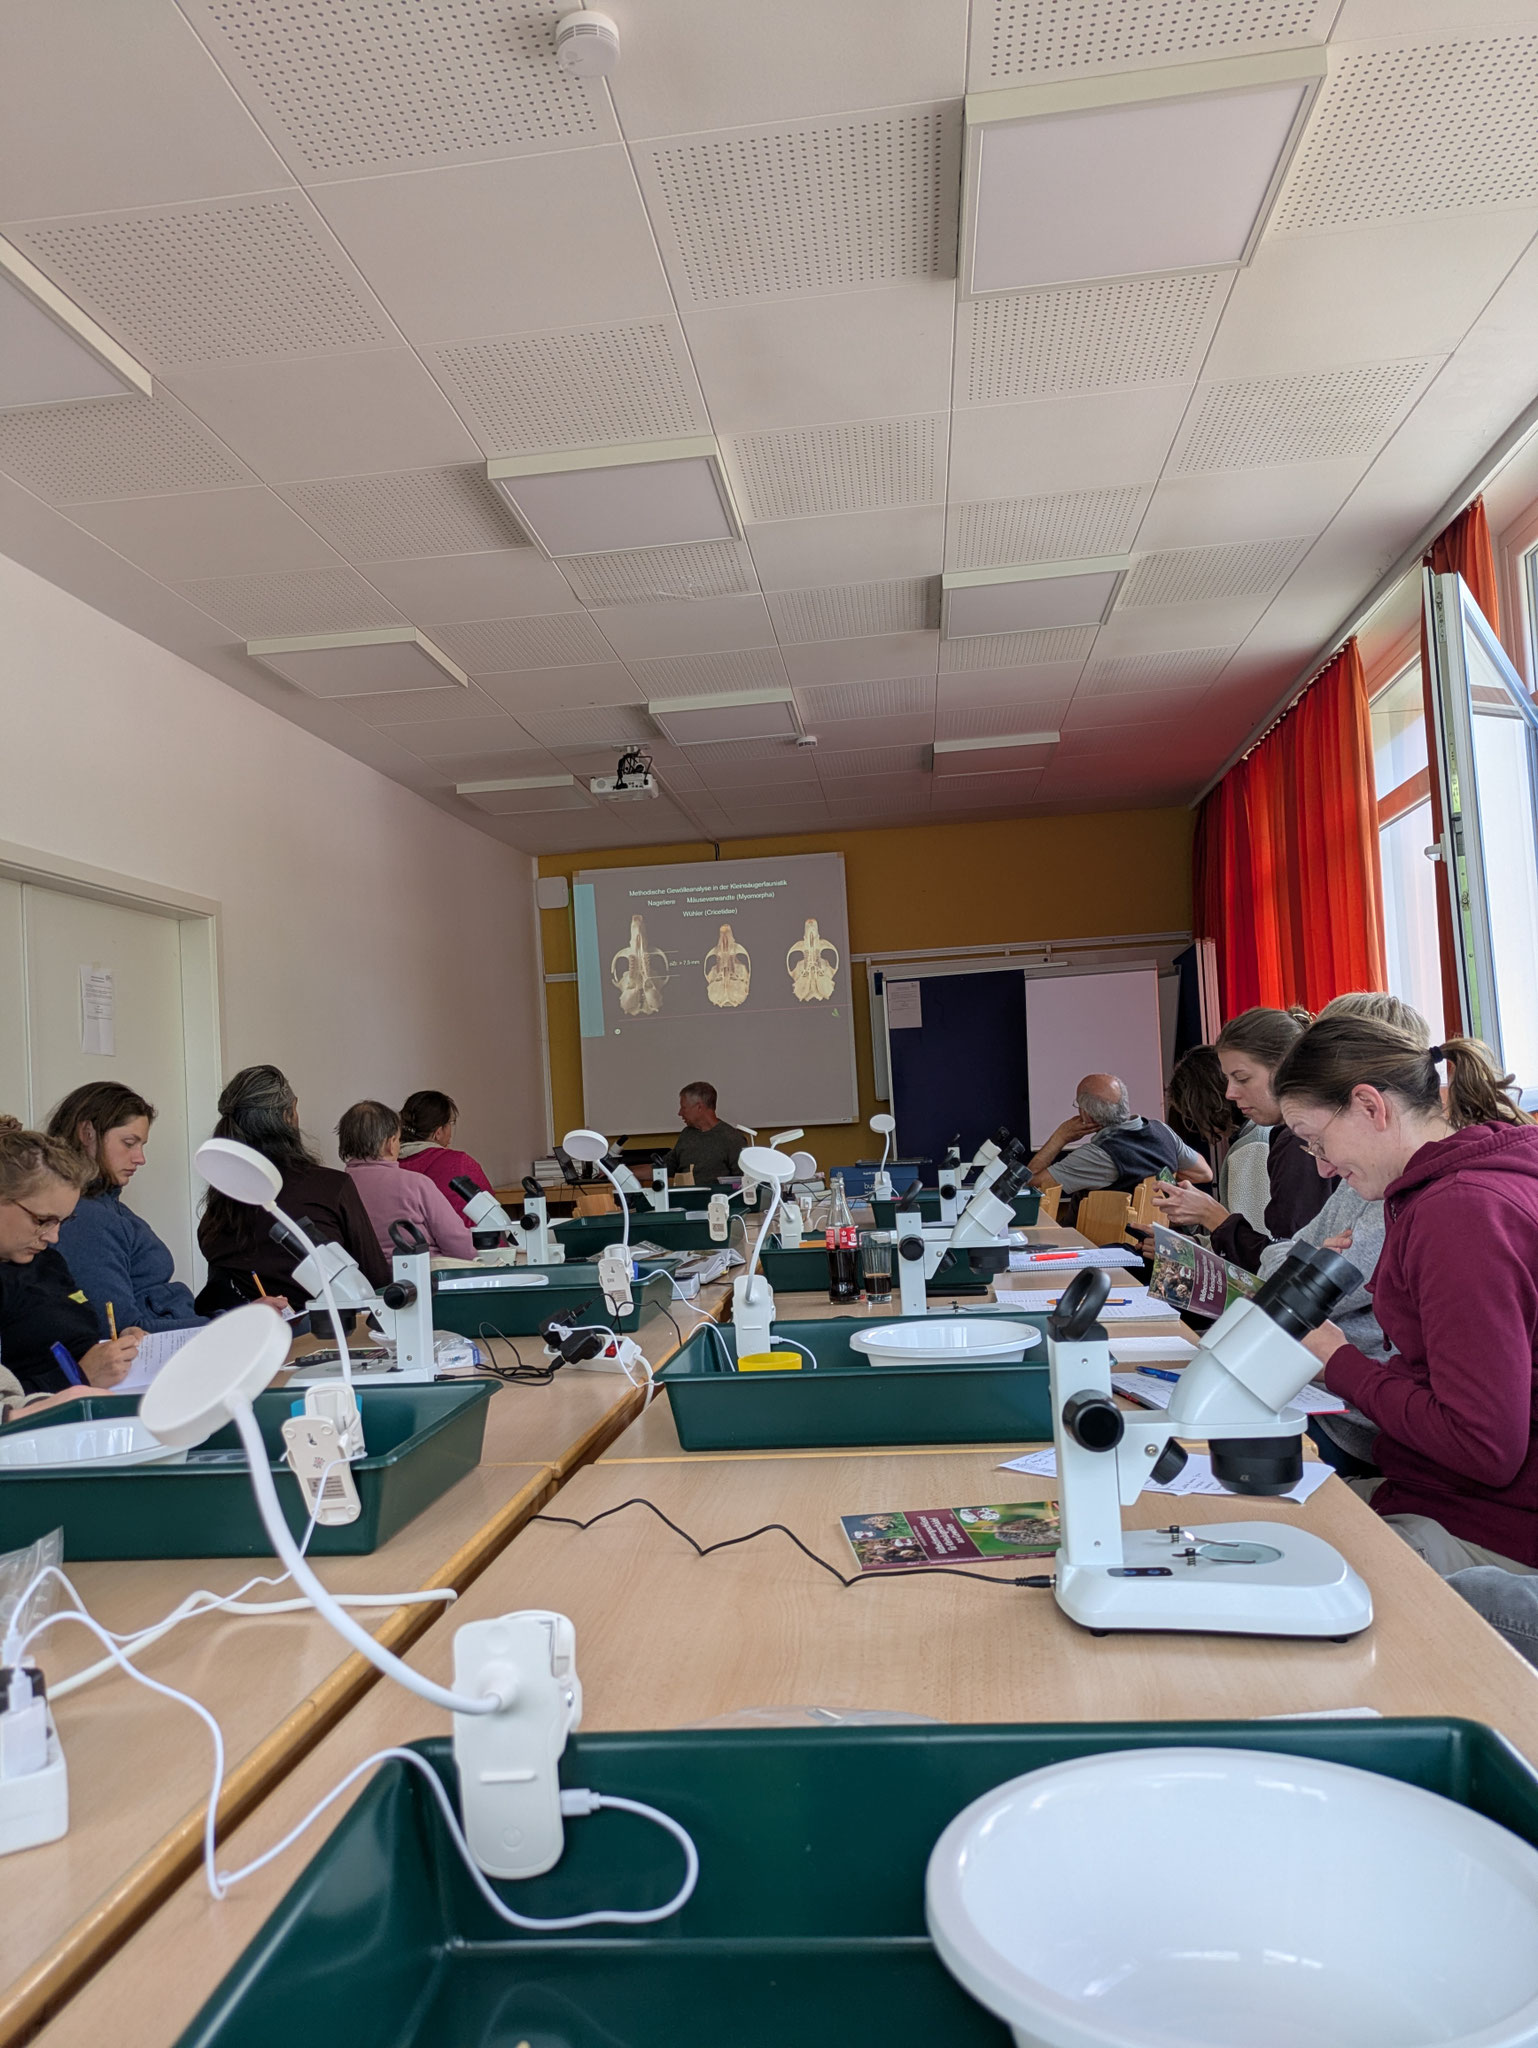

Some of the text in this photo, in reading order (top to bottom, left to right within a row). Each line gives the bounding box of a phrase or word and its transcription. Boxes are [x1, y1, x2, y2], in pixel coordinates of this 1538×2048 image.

[629, 889, 666, 897] Methodische
[666, 885, 711, 895] Gewölleanalyse
[736, 891, 775, 902] (Myomorpha)
[682, 907, 738, 917] Wühler (Cricetidae)
